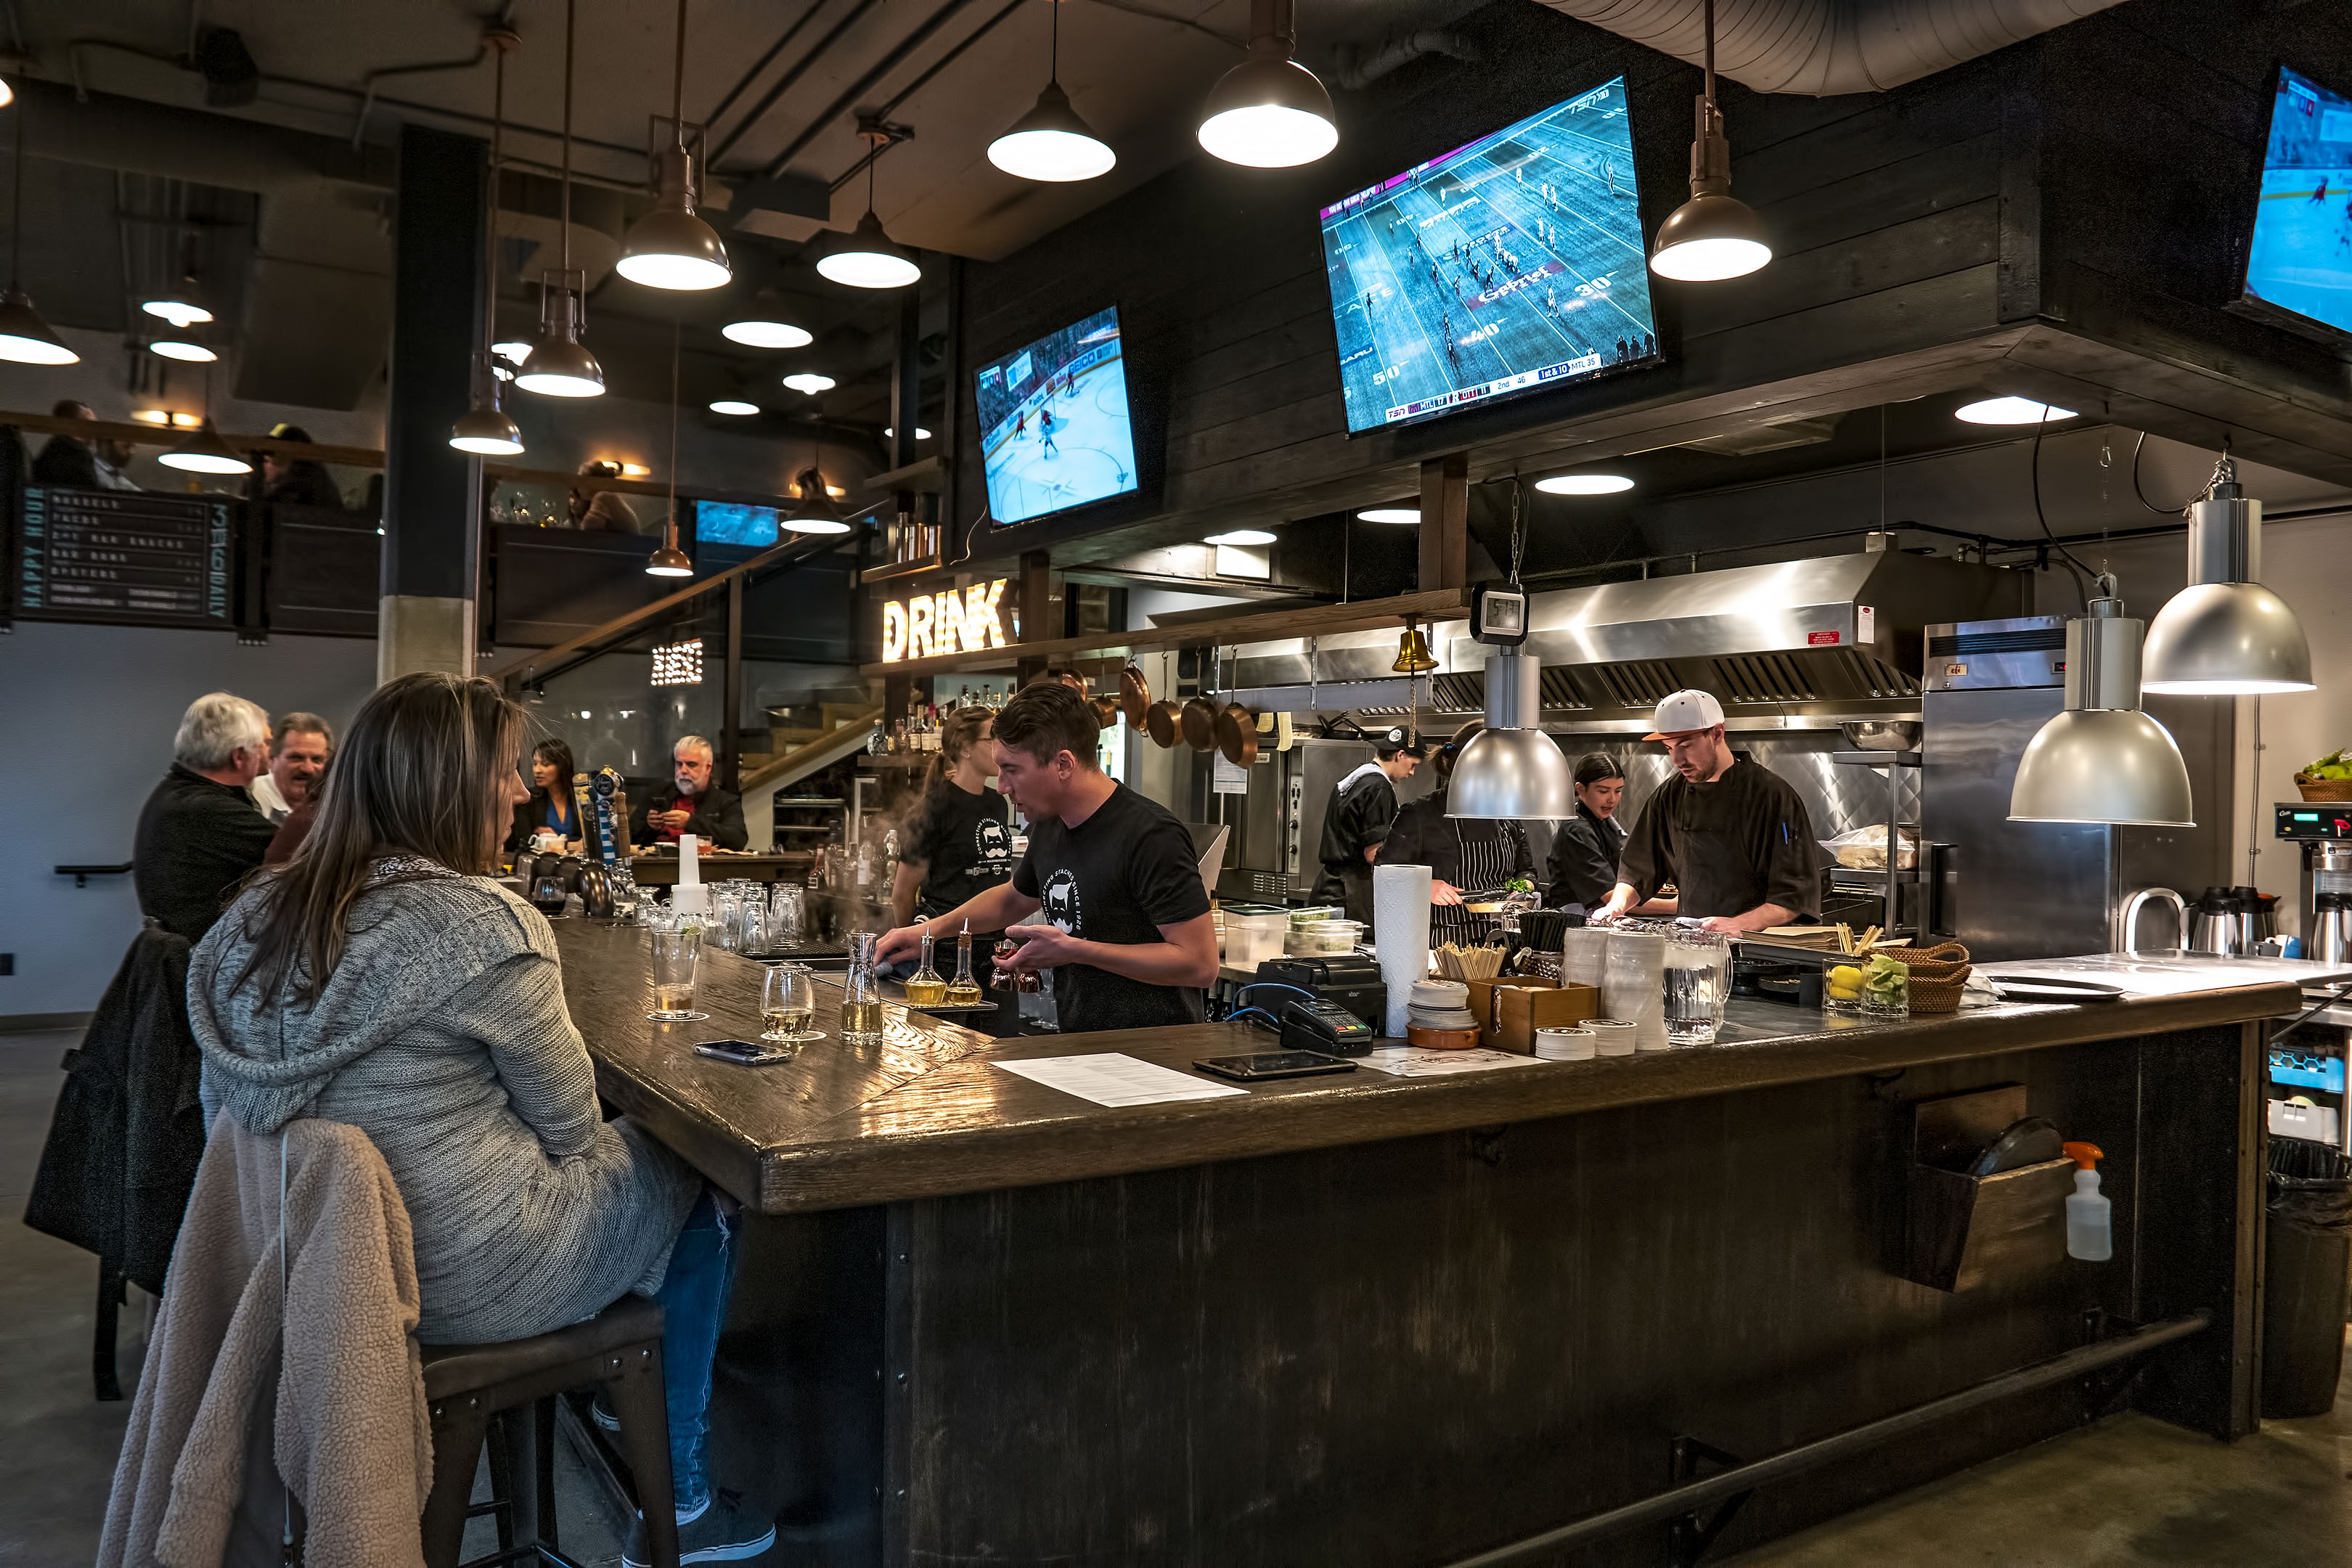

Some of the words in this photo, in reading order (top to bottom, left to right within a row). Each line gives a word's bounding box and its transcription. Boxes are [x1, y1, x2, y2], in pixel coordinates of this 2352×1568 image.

[1069, 352, 1095, 374] GEICO
[1372, 365, 1400, 385] 50
[1388, 408, 1405, 418] TSN
[1421, 400, 1434, 411] MTL
[1437, 396, 1444, 406] 17
[1498, 380, 1510, 390] 2nd
[1571, 361, 1585, 371] MTL
[1587, 357, 1596, 367] 35
[24, 487, 44, 537] HOUR
[23, 546, 43, 608] HAPPY
[209, 574, 226, 618] DAILY
[883, 579, 1008, 663] DRINK
[1055, 869, 1074, 881] STACHES
